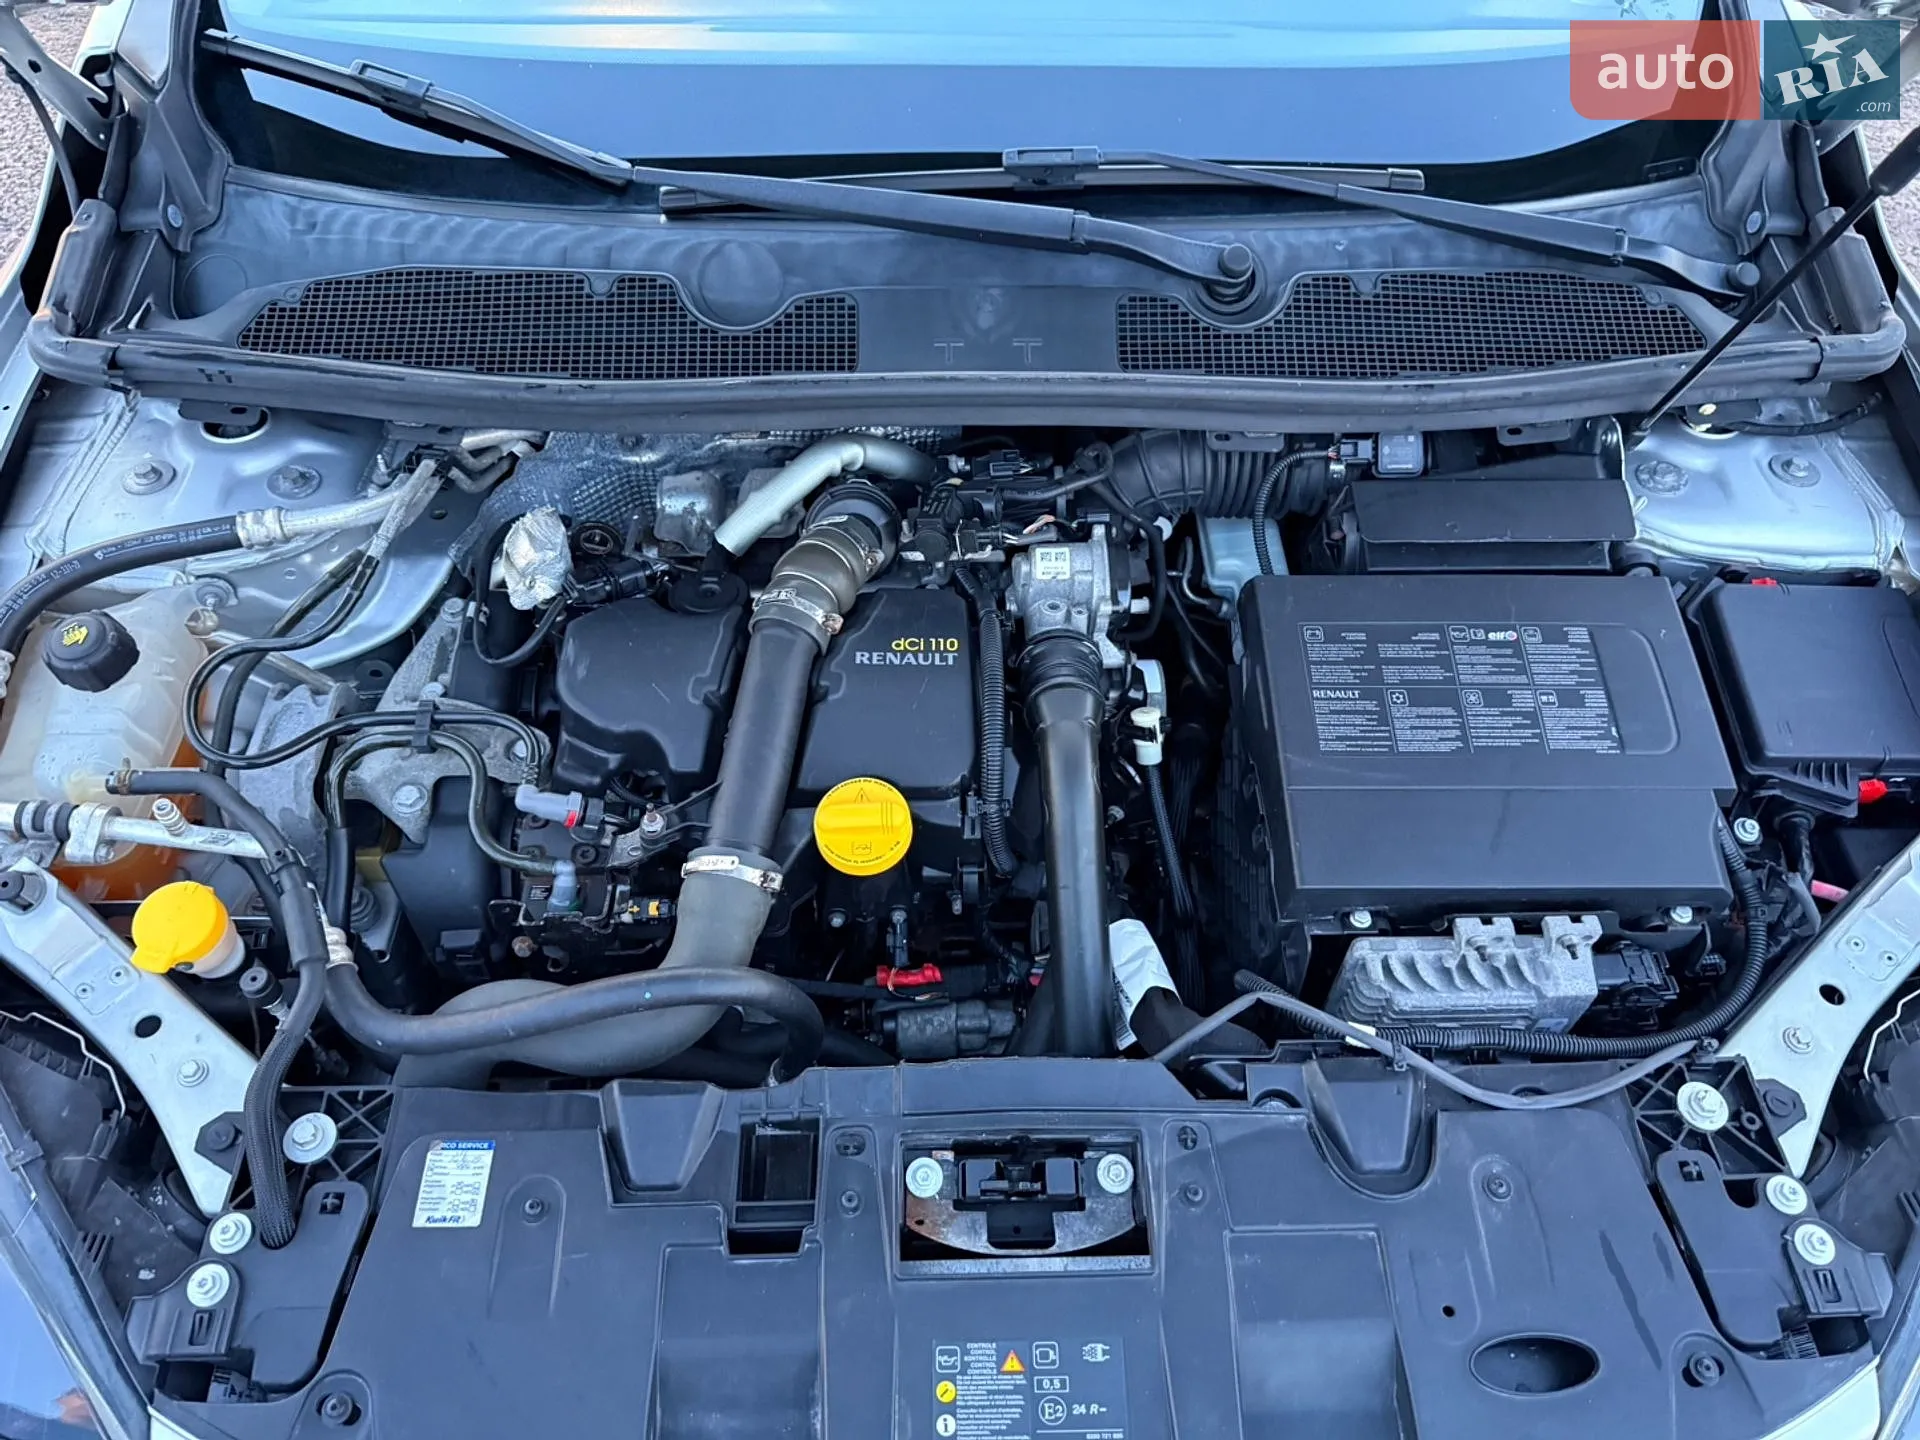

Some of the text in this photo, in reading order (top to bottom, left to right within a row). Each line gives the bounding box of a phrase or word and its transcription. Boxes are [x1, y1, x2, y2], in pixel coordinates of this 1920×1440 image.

[892, 637, 958, 651] dCi 110
[855, 652, 959, 666] RENAULT
[1312, 690, 1361, 700] RENAULT
[458, 1142, 489, 1150] SERVICE
[1042, 1379, 1061, 1390] 0,5
[1043, 1402, 1063, 1420] E2
[1072, 1404, 1086, 1415] 24
